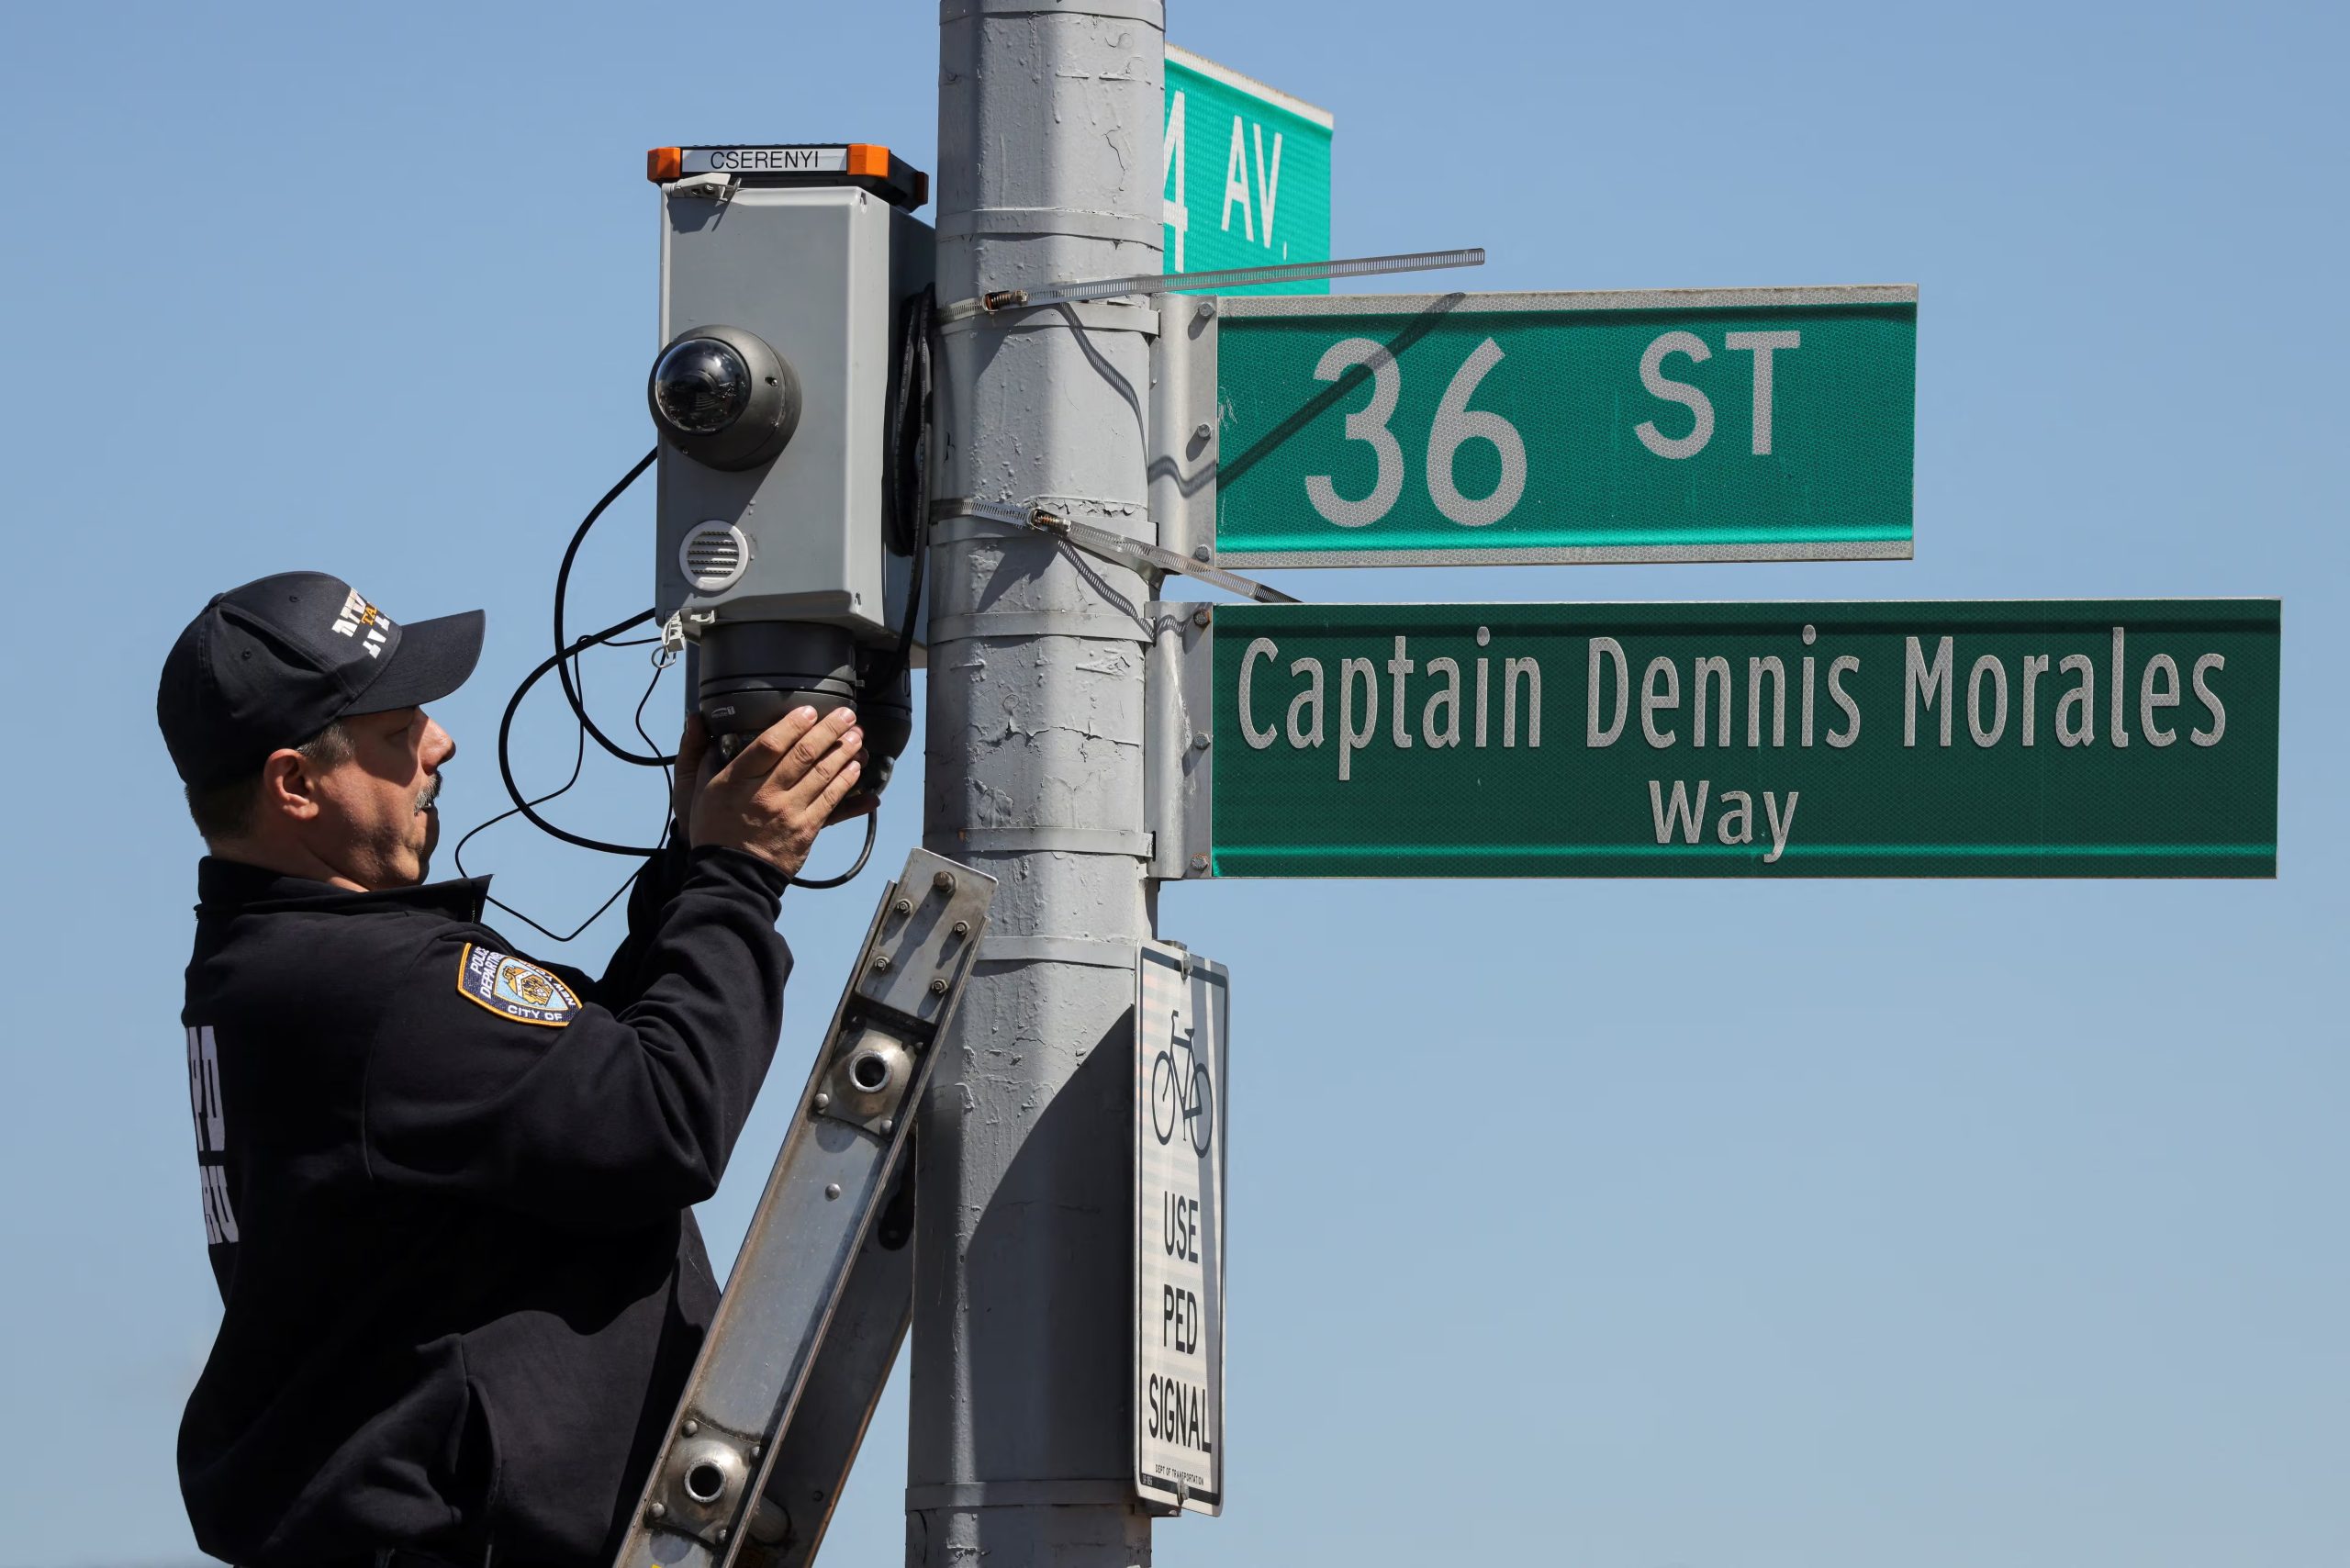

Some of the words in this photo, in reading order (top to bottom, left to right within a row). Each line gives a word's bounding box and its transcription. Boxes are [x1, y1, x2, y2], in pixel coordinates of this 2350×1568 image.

[711, 151, 819, 169] CSERENYI
[1163, 90, 1188, 273] 4
[1304, 336, 1528, 528] 36
[1633, 330, 1801, 460] ST
[361, 602, 378, 626] TA
[1238, 626, 1541, 781] Captain
[1586, 624, 1862, 749] Dennis
[1903, 626, 2226, 748] Morales
[1649, 779, 1799, 863] Way
[507, 1004, 541, 1019] CITY
[544, 1012, 563, 1021] OF
[1164, 1191, 1199, 1264] USE
[1163, 1283, 1198, 1355] PED
[1148, 1372, 1213, 1454] SIGNAL
[1166, 1467, 1171, 1476] OF
[1171, 1468, 1204, 1486] TRANSPORTATION
